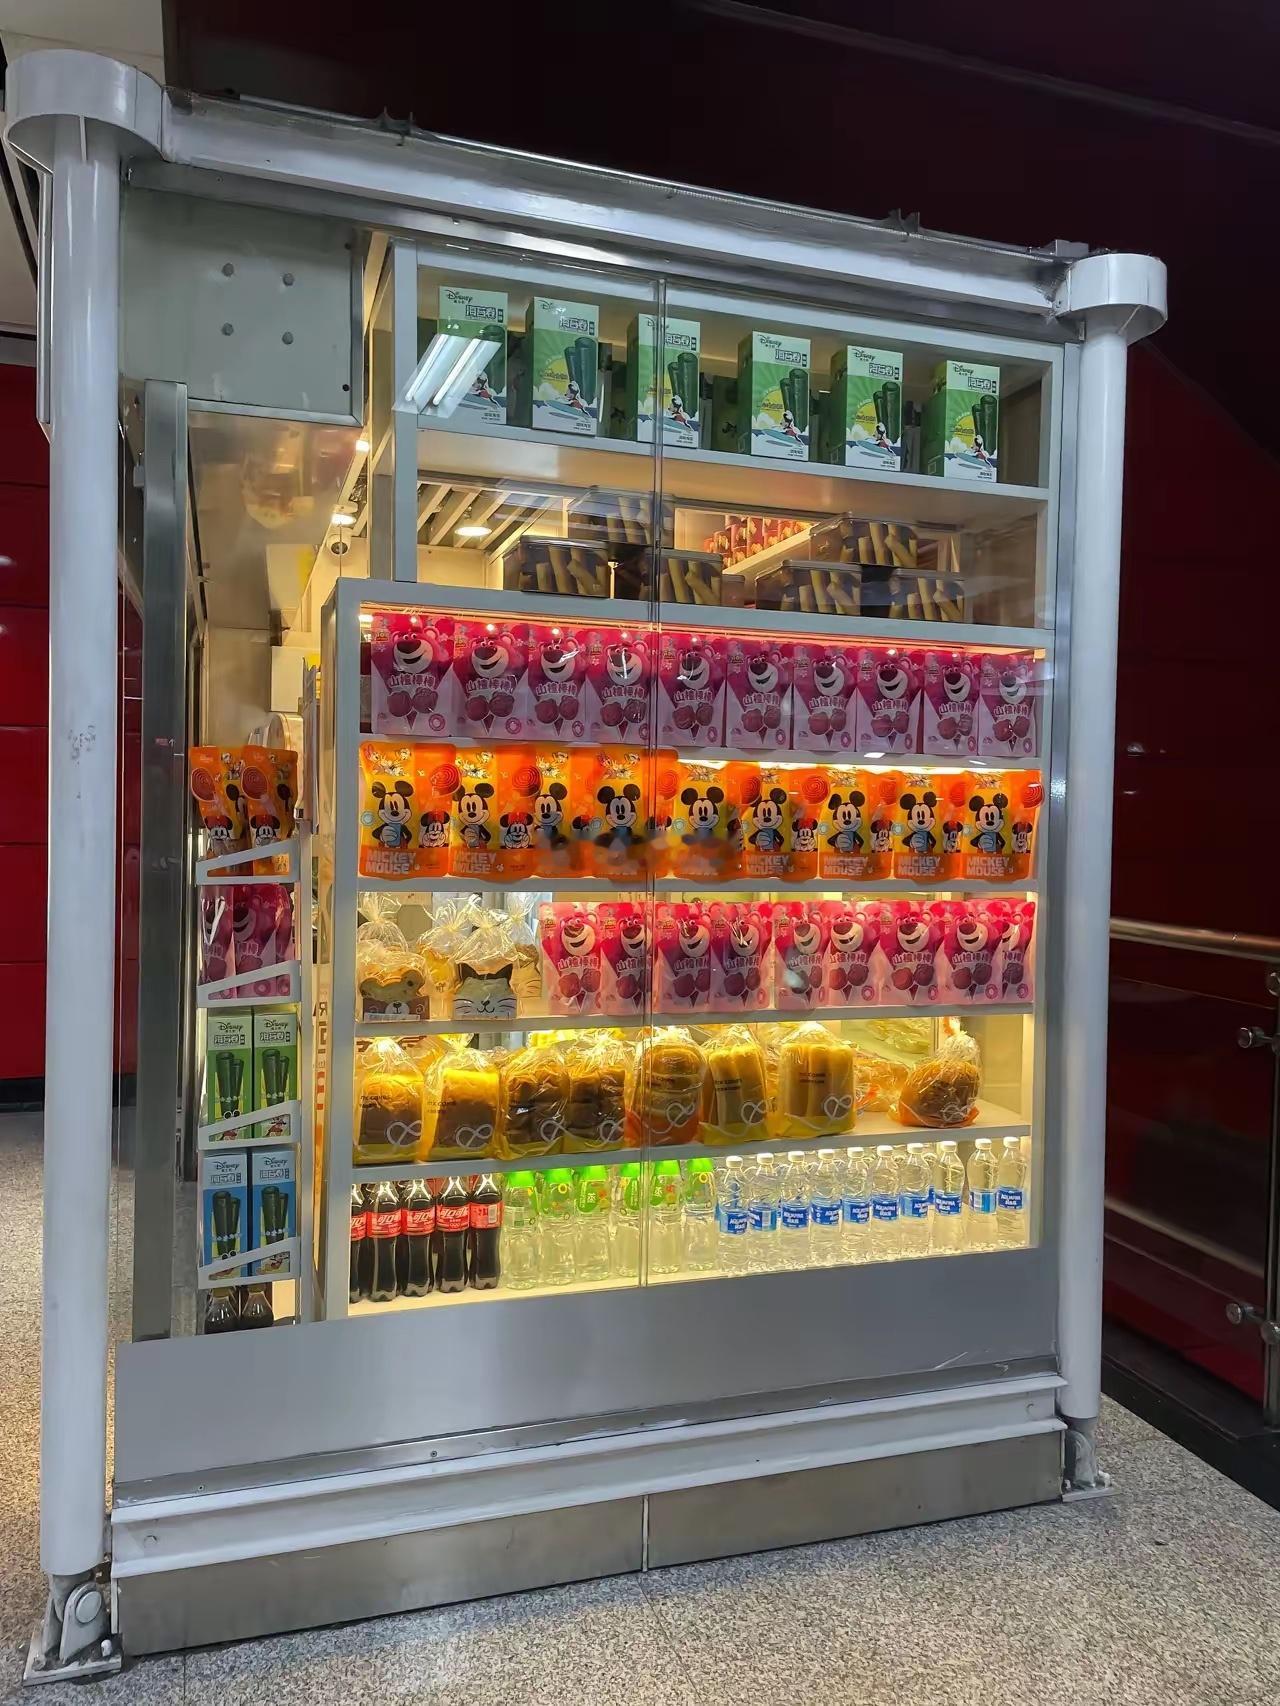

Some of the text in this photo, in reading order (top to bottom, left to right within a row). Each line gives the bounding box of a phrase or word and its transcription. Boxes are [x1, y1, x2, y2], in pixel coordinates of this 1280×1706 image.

[444, 289, 473, 304] Disney
[757, 334, 782, 348] Disney
[851, 348, 876, 361] Disney
[952, 362, 975, 376] Disney
[367, 851, 416, 865] MICKEY
[897, 856, 940, 868] MICKEY
[967, 856, 1010, 868] MICKEY
[365, 862, 409, 874] MOUSE
[896, 866, 938, 877] MOUSE
[965, 866, 1005, 877] MOUSE
[216, 1021, 244, 1032] Disney
[263, 1018, 289, 1030] Disney
[213, 1160, 240, 1170] Disney
[263, 1156, 288, 1167] Disney
